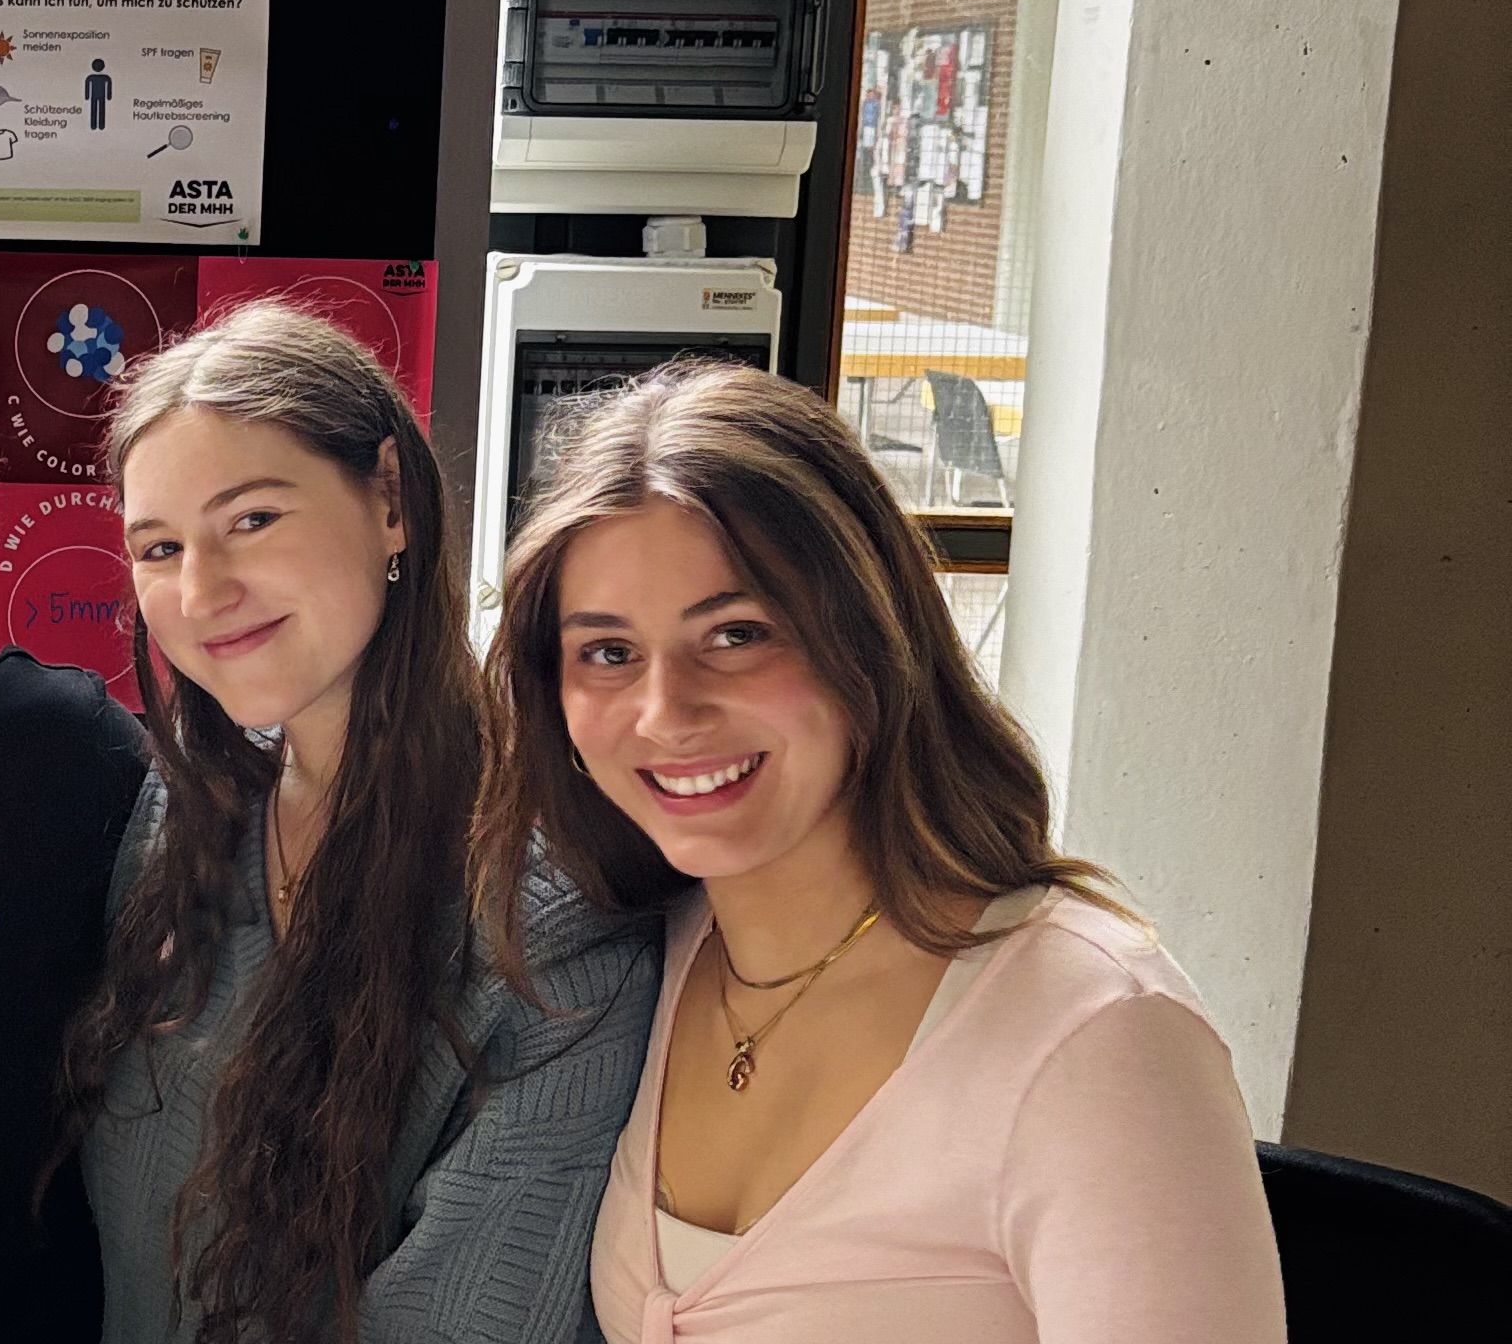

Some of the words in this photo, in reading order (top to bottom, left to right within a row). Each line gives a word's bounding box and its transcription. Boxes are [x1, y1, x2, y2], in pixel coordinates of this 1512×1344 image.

[158, 0, 172, 7] zu
[23, 29, 110, 41] Sonnenexposition
[23, 42, 61, 51] meiden
[142, 48, 157, 57] SPF
[161, 48, 194, 59] tragen
[24, 105, 82, 114] Schützende
[133, 98, 203, 110] Regelmäßiges
[24, 117, 67, 129] Kleidung
[133, 111, 230, 123] Hautkrebsscreening
[24, 130, 57, 140] tragen
[169, 180, 233, 199] ASTA
[168, 203, 196, 214] DER
[200, 203, 233, 214] MHH
[7, 395, 20, 405] C
[10, 413, 36, 448] WIE
[36, 449, 97, 477] COLOR
[3, 514, 36, 551] WIE
[0, 560, 13, 572] D
[50, 591, 120, 624] 5mm
